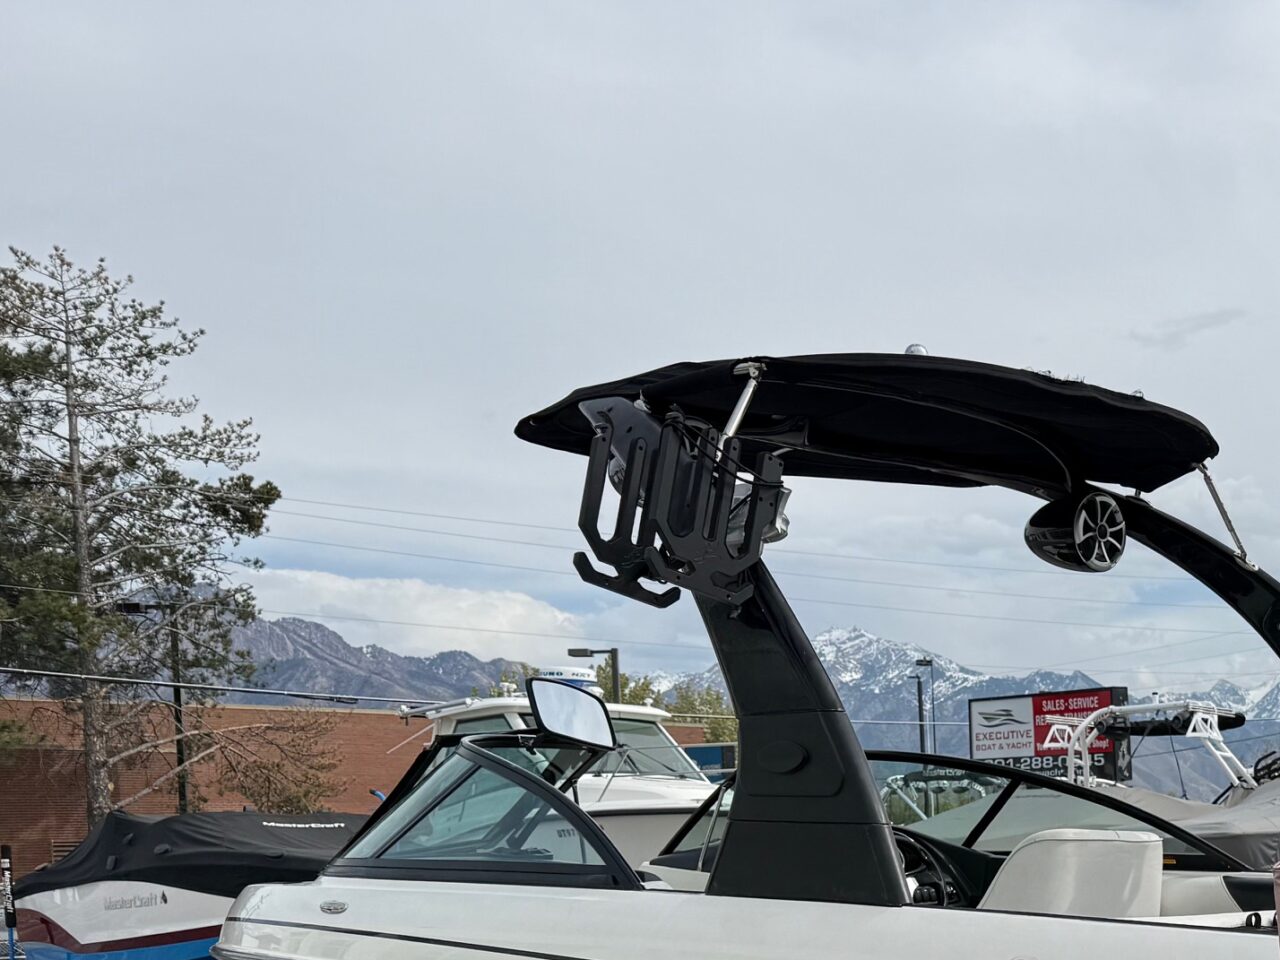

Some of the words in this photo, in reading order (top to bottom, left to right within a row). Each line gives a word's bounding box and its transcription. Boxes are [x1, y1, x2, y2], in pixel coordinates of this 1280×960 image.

[975, 729, 1032, 741] EXECUTIVE
[975, 743, 997, 751] BOAT
[1006, 741, 1032, 750] YACHT
